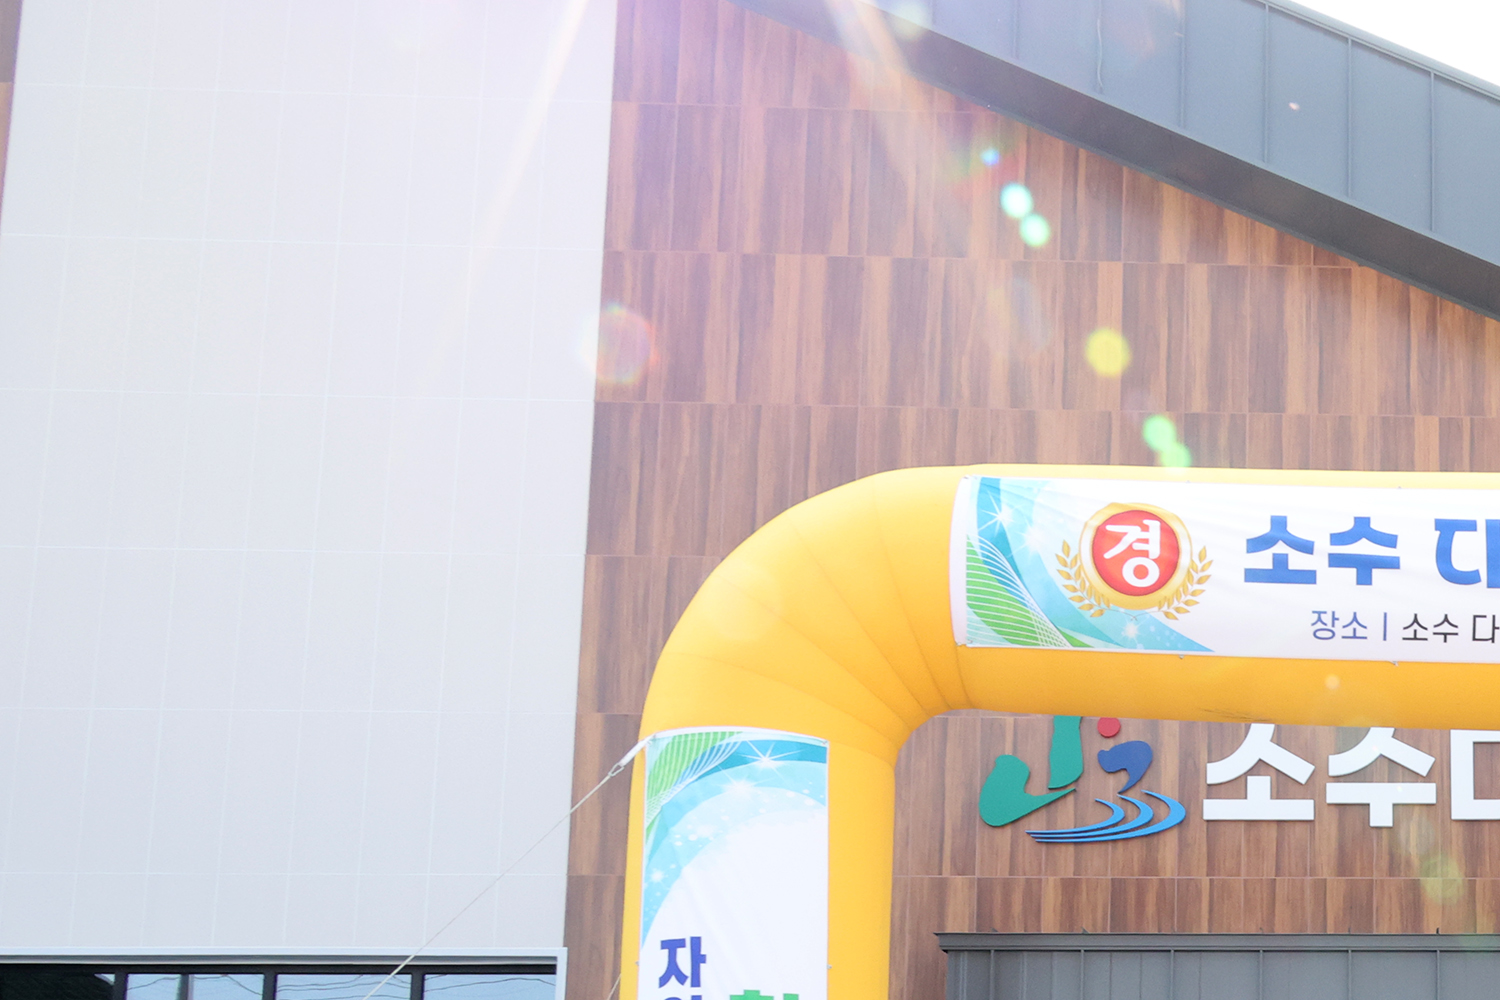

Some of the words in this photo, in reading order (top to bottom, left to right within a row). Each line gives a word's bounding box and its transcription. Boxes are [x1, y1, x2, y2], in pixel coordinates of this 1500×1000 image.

[1102, 516, 1178, 588] 경
[1243, 515, 1402, 586] 소수
[1309, 610, 1368, 643] 장소
[1401, 613, 1460, 643] 소수
